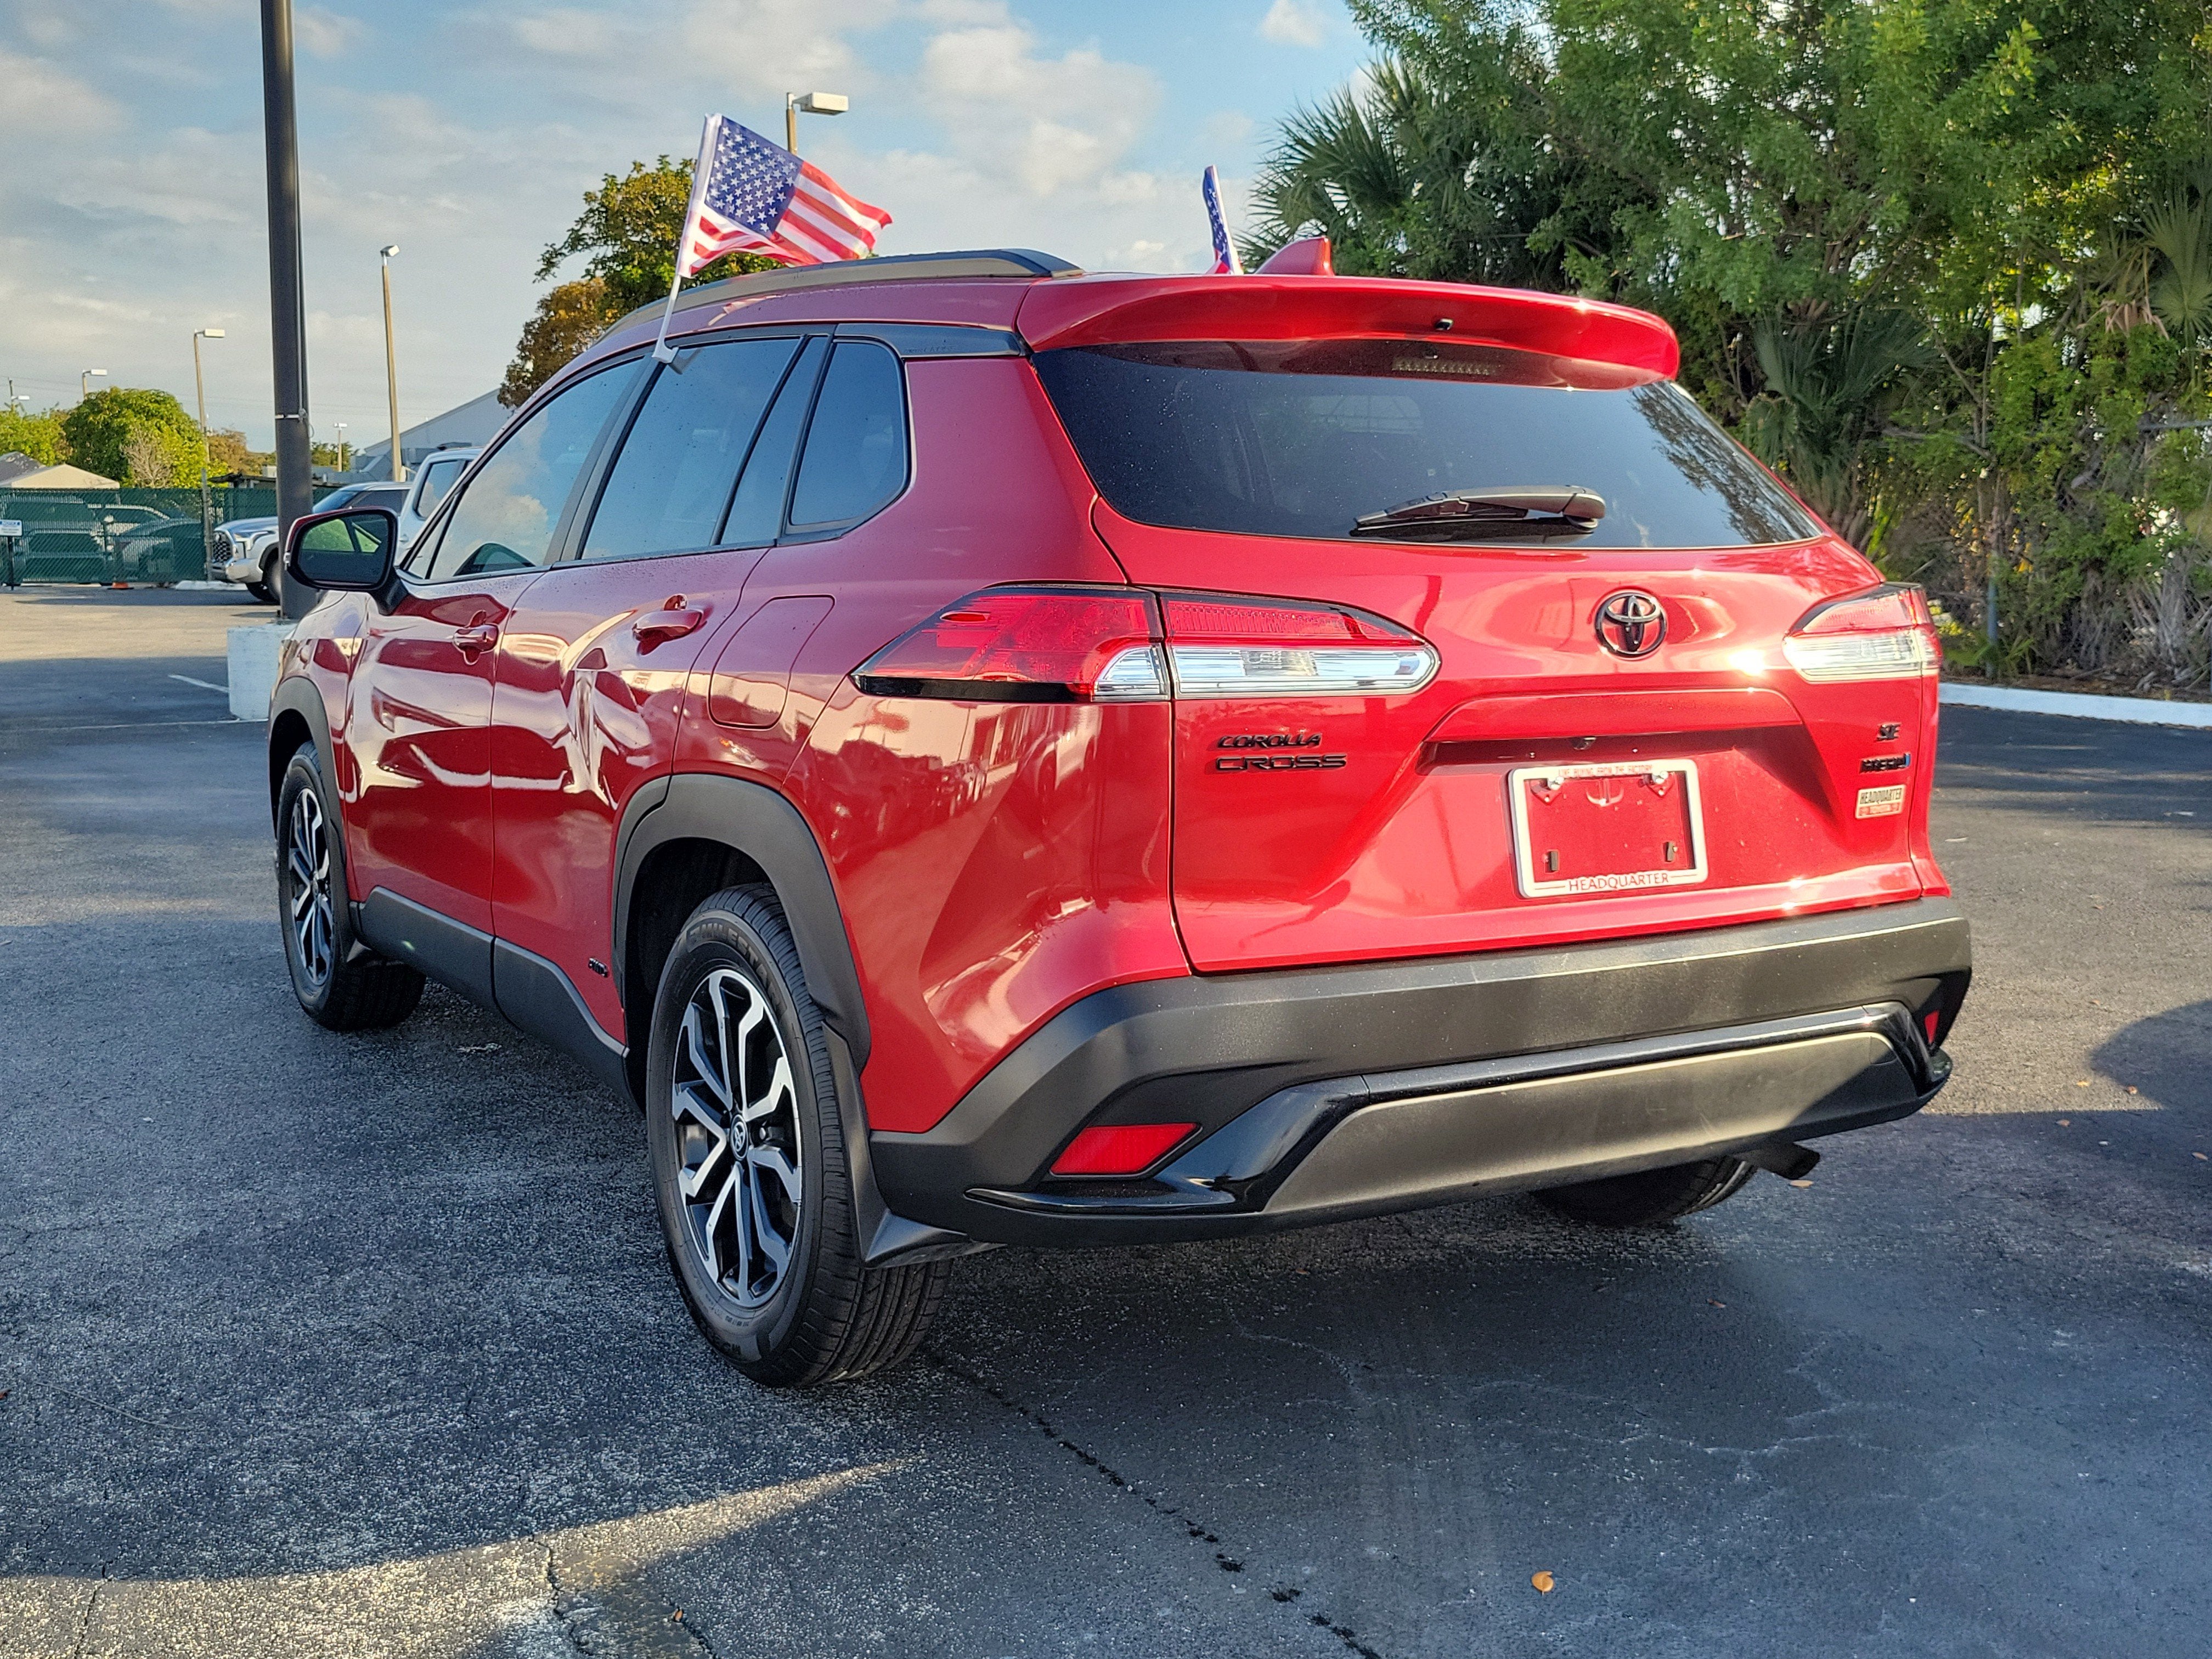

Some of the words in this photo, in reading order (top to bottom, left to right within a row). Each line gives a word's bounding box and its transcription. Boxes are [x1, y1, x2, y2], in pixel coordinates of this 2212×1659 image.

[1218, 733, 1322, 748] COROLLA
[1876, 724, 1901, 741] SE
[1216, 754, 1347, 770] CROSS
[1569, 873, 1669, 891] HEADQUARTER
